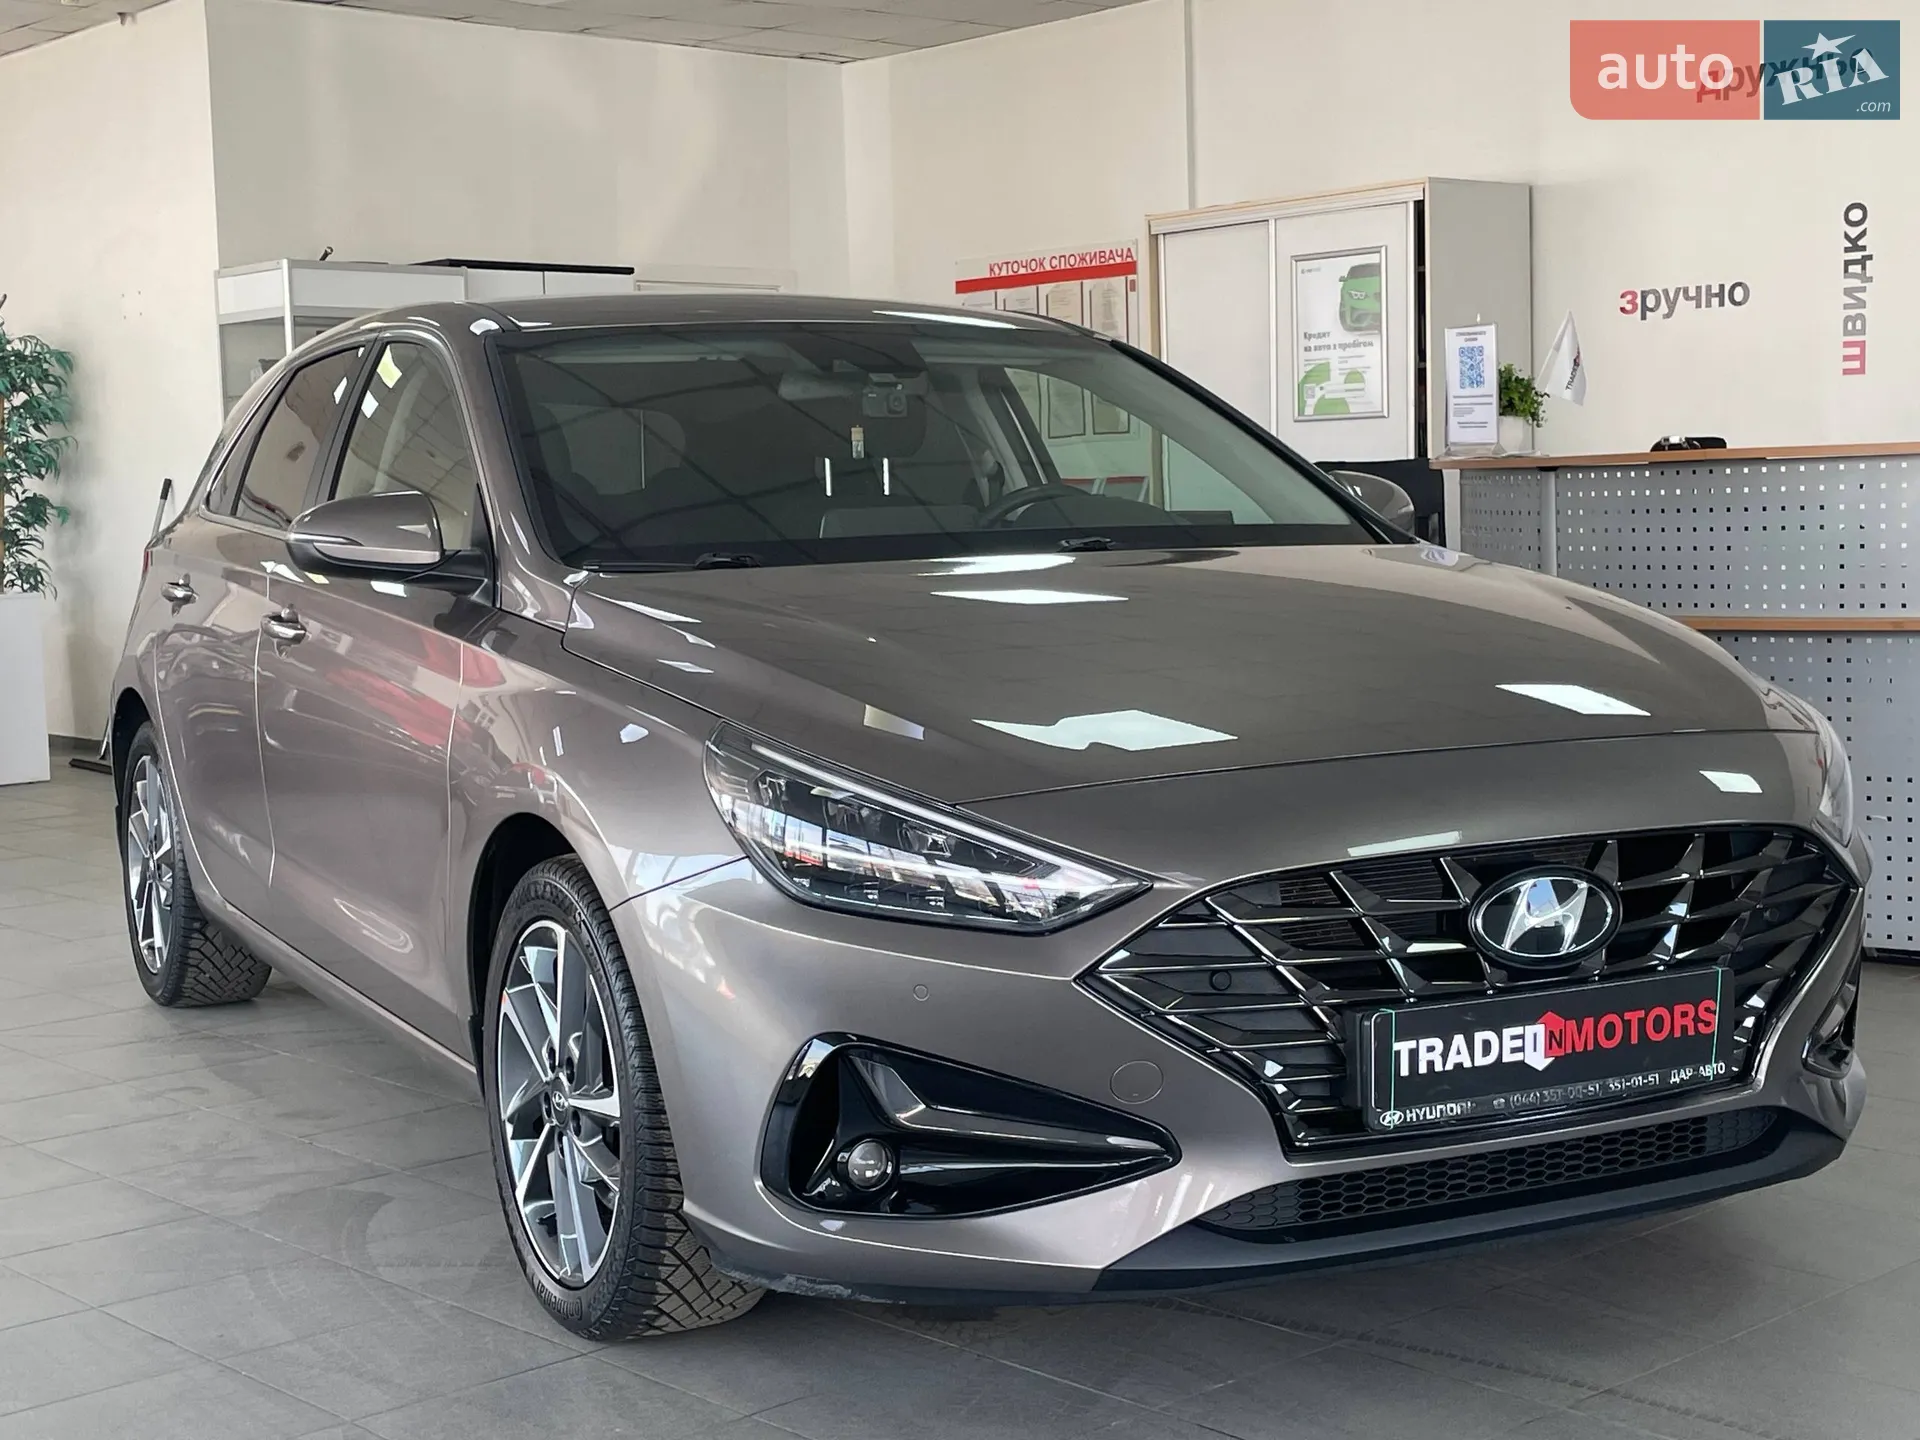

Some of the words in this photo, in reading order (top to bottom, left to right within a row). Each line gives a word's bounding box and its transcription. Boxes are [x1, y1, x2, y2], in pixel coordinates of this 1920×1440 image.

[989, 257, 1046, 277] КУТОЧОК
[1049, 247, 1134, 269] СПОЖИВАЧА
[1619, 281, 1750, 320] зручно
[1303, 332, 1331, 341] Кредит
